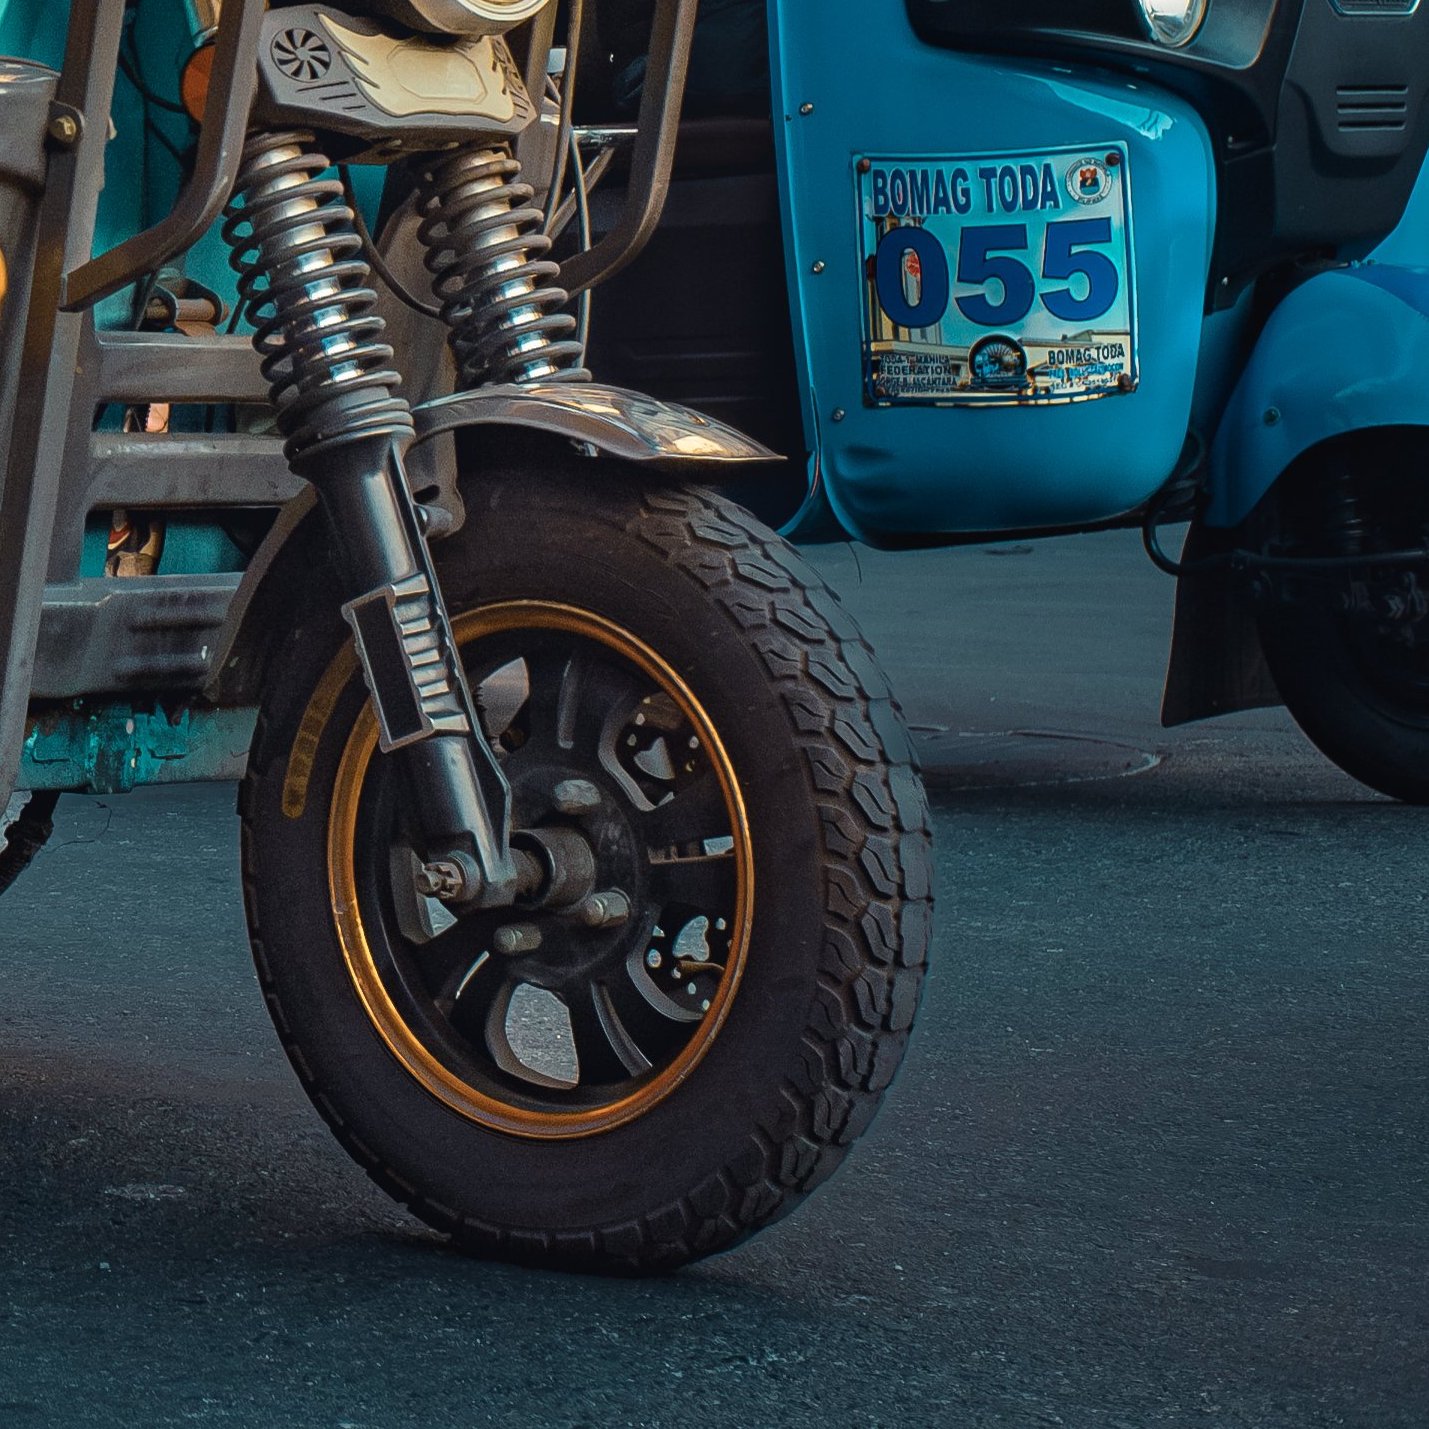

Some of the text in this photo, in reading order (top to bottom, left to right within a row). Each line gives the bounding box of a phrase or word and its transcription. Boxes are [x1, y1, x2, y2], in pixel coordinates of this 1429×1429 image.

[872, 167, 972, 217] BOMAG
[978, 162, 1060, 213] TODA
[875, 217, 1120, 328] 055
[1047, 343, 1126, 366] BOMAG TODA
